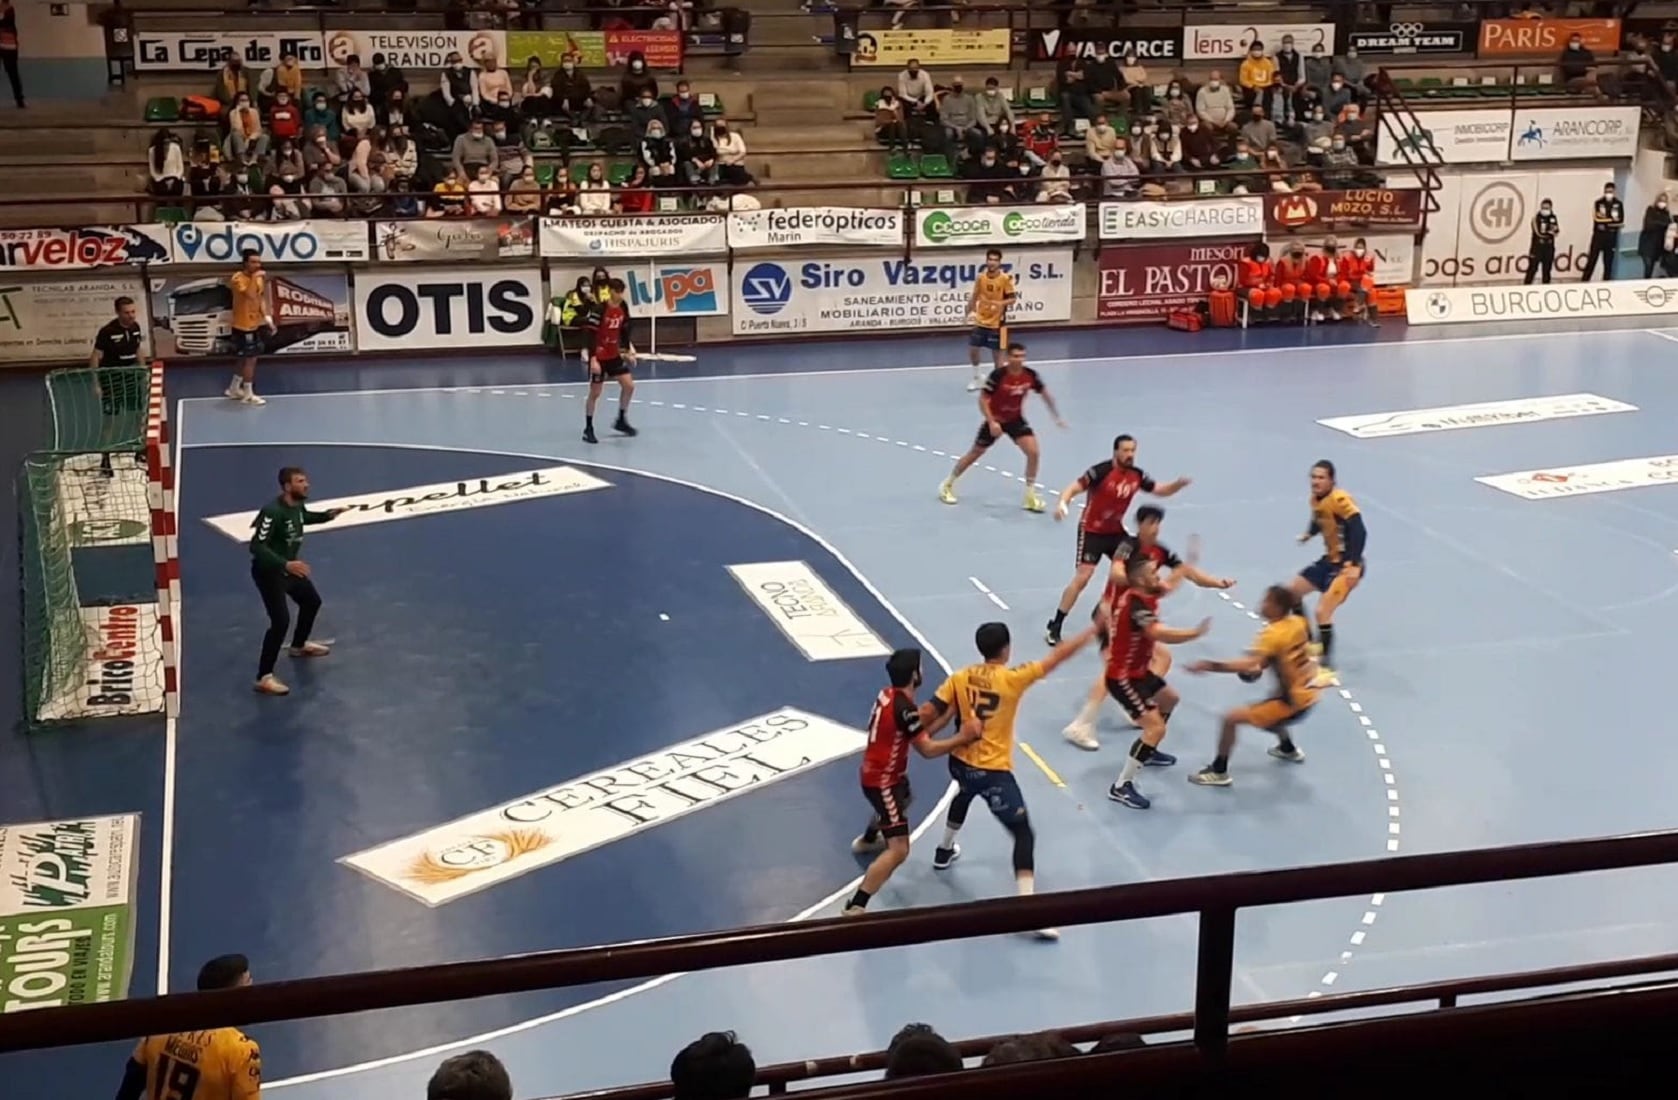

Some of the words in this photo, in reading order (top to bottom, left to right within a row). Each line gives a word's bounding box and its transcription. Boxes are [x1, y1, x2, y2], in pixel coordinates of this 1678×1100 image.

[1194, 29, 1233, 54] lens
[1357, 38, 1409, 47] DREAM
[1414, 37, 1455, 45] TEAM
[1485, 23, 1556, 48] PARÍS
[139, 40, 169, 63] La
[245, 40, 271, 61] de
[377, 52, 462, 67] RANDA
[1072, 40, 1174, 58] VACARCE
[1345, 190, 1394, 203] LUCIO
[600, 217, 643, 227] CUESTA
[658, 216, 723, 226] ASOCIADOS
[768, 210, 897, 232] federópticos
[1125, 207, 1258, 228] EASYCHARGER
[605, 237, 680, 248] HISPAJURIS
[1485, 244, 1589, 275] arada
[801, 262, 865, 289] Siro
[1029, 263, 1064, 280] S.L.
[1101, 269, 1134, 296] EL
[627, 268, 714, 312] lupa
[844, 294, 930, 306] SANEAMIENTO
[1471, 288, 1614, 315] BURGOCAR
[366, 280, 534, 338] OTIS
[820, 305, 905, 319] MOBILIARIO
[910, 307, 928, 315] DE
[347, 472, 551, 512] rpellet
[761, 581, 811, 619] TECNO
[500, 714, 809, 823] CEREALES
[591, 754, 811, 827] FIEL
[441, 843, 495, 866] CF
